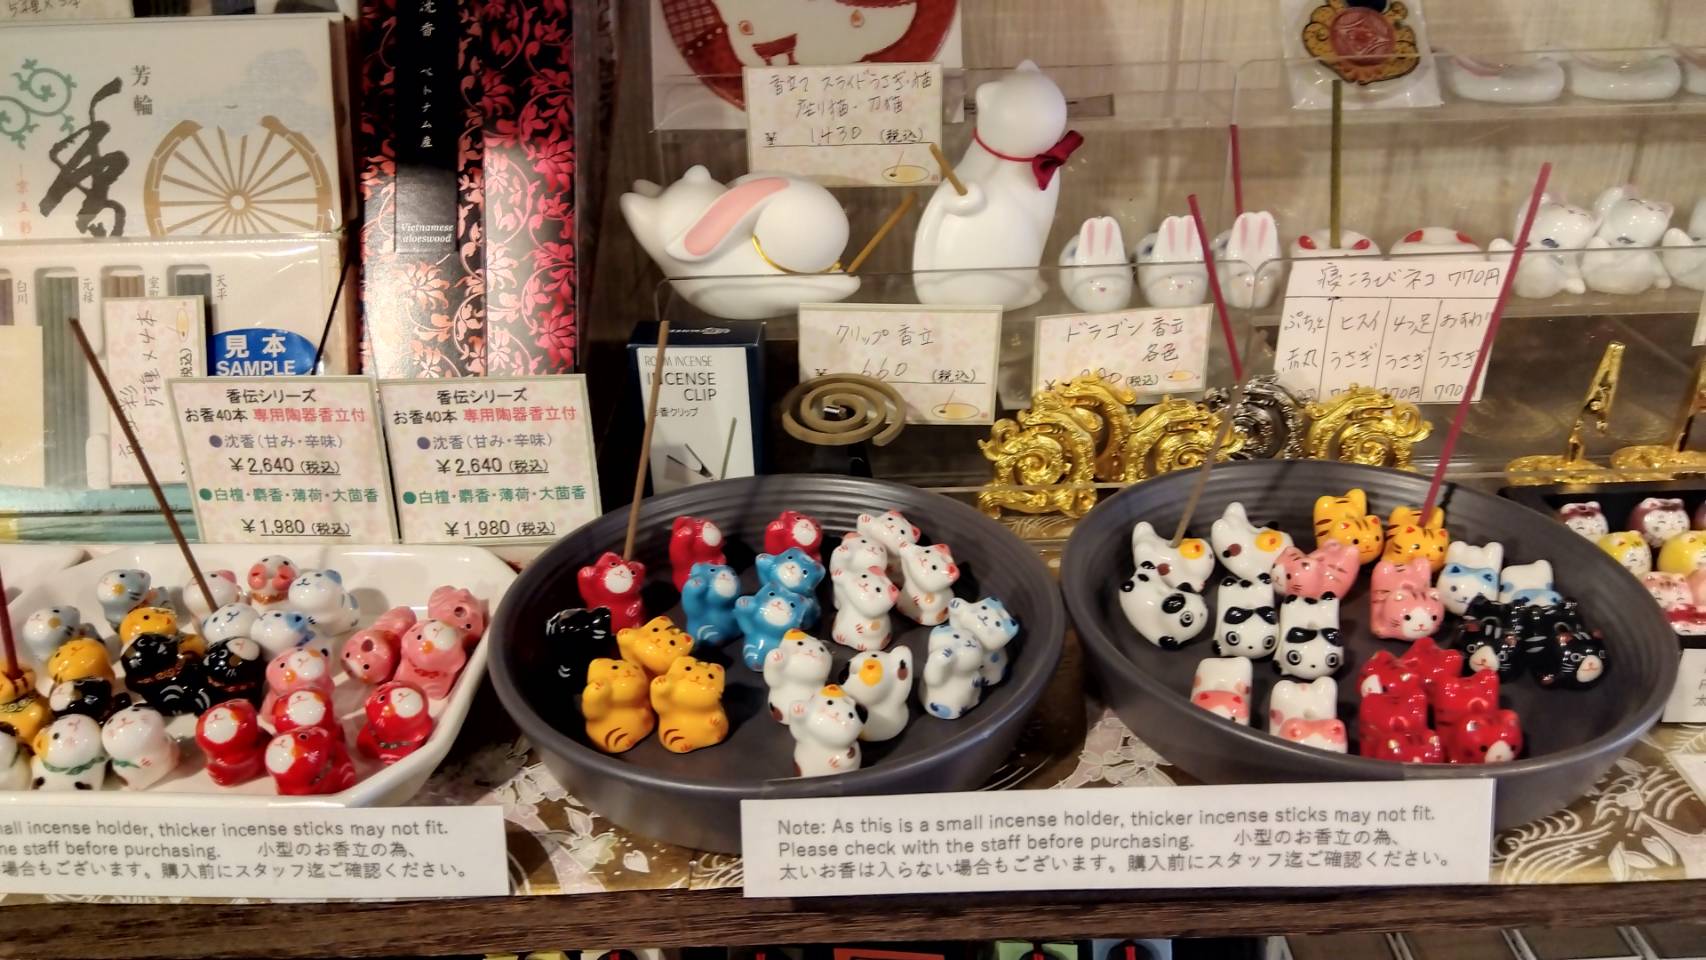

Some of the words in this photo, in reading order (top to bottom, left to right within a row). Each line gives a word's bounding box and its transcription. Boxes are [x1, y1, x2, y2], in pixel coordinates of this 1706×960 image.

[811, 126, 862, 144] 1430
[401, 223, 454, 232] Vietnamese
[1448, 267, 1500, 287] 770円
[836, 324, 890, 346] クリップ
[898, 323, 936, 346] 香立
[1067, 318, 1144, 342] ドラゴン
[1151, 316, 1185, 337] 香立
[224, 334, 287, 358] 見本
[180, 348, 194, 377] 税込)
[216, 360, 296, 376] SAMPLE
[645, 355, 673, 366] ROM
[675, 355, 713, 367] INCENSE
[647, 372, 716, 387] ICENSE
[931, 368, 976, 384] (税込)
[226, 388, 317, 404] 香伝シリーズ
[437, 387, 528, 405] 香伝シリーズ
[684, 388, 717, 402] CLIP
[1434, 383, 1475, 400] 770
[185, 408, 248, 423] お香40本
[253, 407, 366, 423] 専用陶器香立付
[393, 409, 458, 425] お香40本
[464, 406, 576, 423] 専用陶器香立付
[300, 460, 341, 474] (税込)
[508, 459, 549, 474] (税込)
[311, 522, 351, 535] (税込)
[516, 521, 556, 536] (税込)
[778, 818, 826, 835] Note:
[832, 818, 854, 833] As
[861, 817, 892, 833] this
[899, 816, 913, 832] is
[920, 820, 930, 832] a
[936, 815, 983, 831] small
[990, 813, 1057, 829] incense
[1064, 810, 1124, 829] holder,
[1130, 808, 1193, 827] thicker
[1199, 808, 1268, 825] incense
[1275, 806, 1328, 823] sticks
[1335, 808, 1371, 826] may
[1377, 806, 1406, 822] not
[1412, 805, 1435, 821] fit.
[28, 821, 91, 836] incense
[97, 820, 154, 838] holder,
[159, 822, 216, 837] thicker
[223, 822, 287, 837] incense
[294, 821, 344, 836] sticks
[351, 823, 385, 838] may
[392, 822, 420, 836] not
[425, 820, 448, 835] fit.
[1234, 828, 1399, 847] 小型のお香立の為、
[23, 840, 59, 856] staff
[66, 841, 118, 856] before
[125, 843, 221, 860] purchasing.
[257, 841, 416, 858] 小型のお香立の為、
[779, 841, 838, 857] Please
[845, 839, 896, 856] check
[902, 838, 940, 855] with
[946, 838, 974, 854] the
[981, 836, 1020, 853] staff
[1027, 834, 1084, 851] before
[1091, 832, 1194, 852] purchasing.
[0, 861, 466, 880] 場合もございます。購入前にスタッフ迄ご確認ください。
